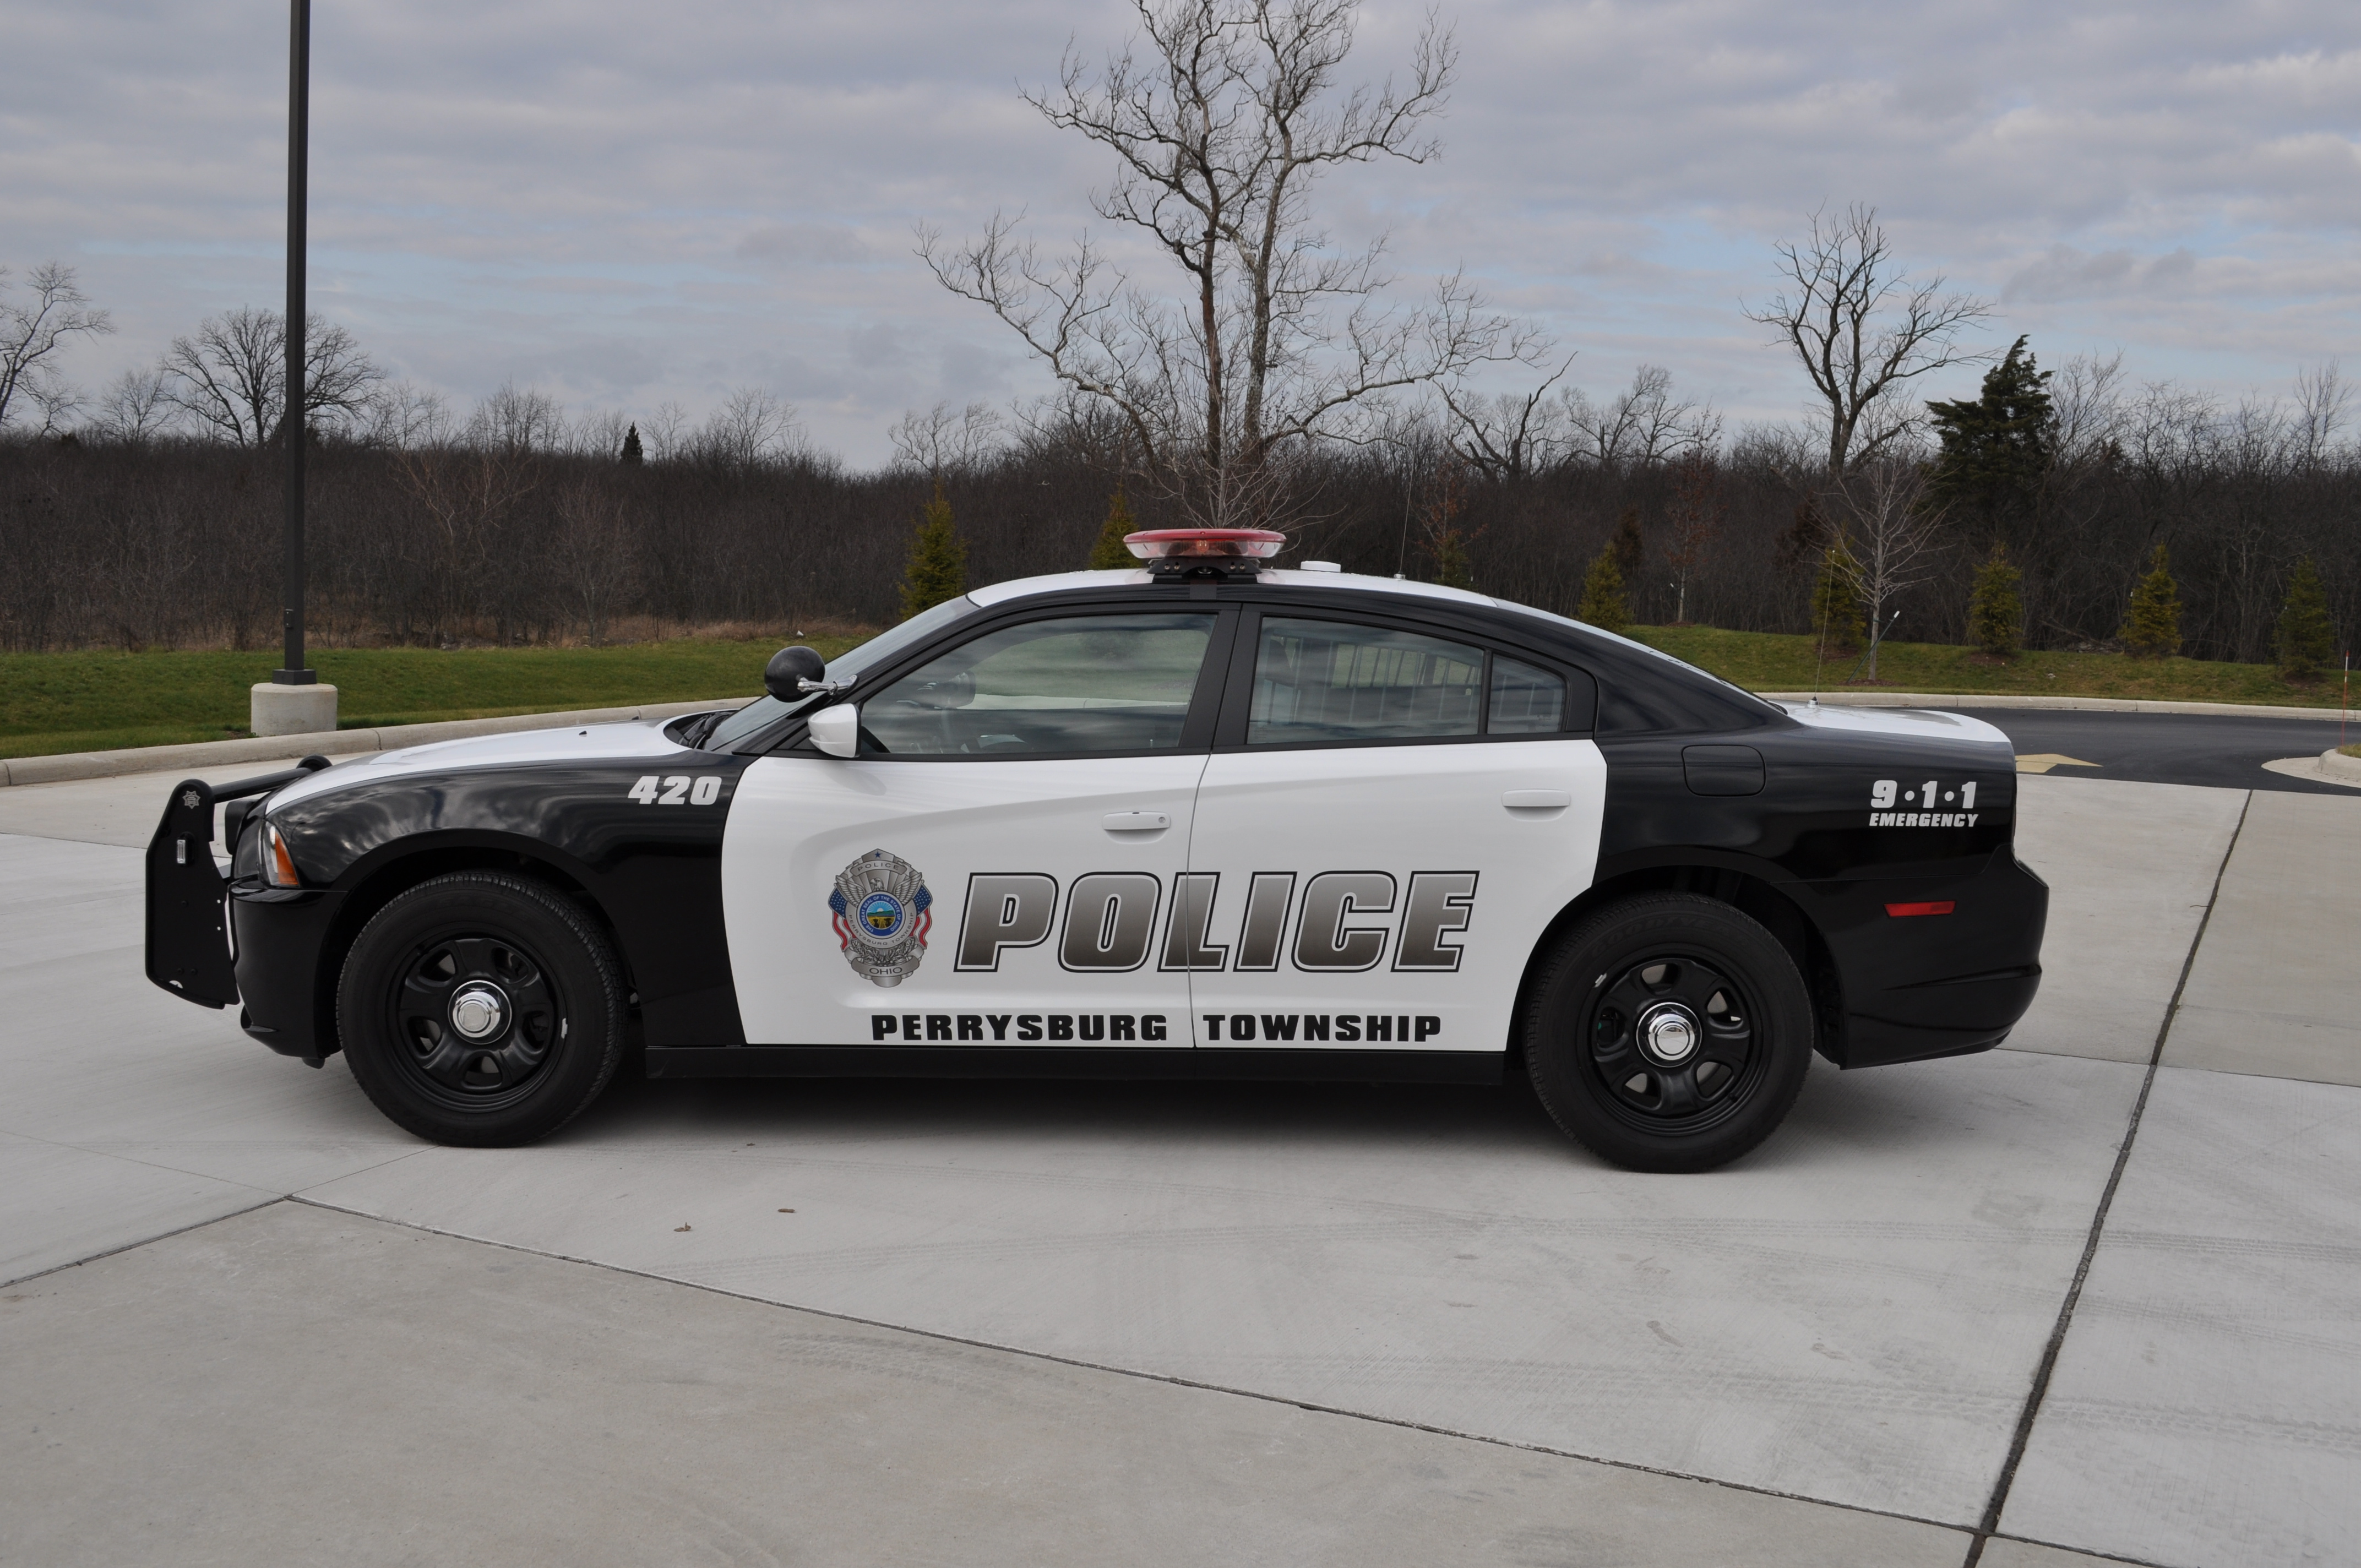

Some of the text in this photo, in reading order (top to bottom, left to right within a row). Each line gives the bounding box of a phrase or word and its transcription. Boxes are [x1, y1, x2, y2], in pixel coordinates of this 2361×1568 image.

[628, 776, 722, 805] 420
[1869, 813, 1979, 827] EMERGENCY
[857, 862, 899, 872] POLICE
[863, 899, 873, 908] SEAL
[890, 900, 900, 913] STATE
[890, 921, 900, 932] OHIO
[953, 870, 1480, 973] POLICE
[848, 912, 914, 945] PERRYSBURG TOWNSHIP
[866, 924, 874, 933] THE
[871, 1014, 1441, 1042] PERRYSBURG TOWNSHIP
